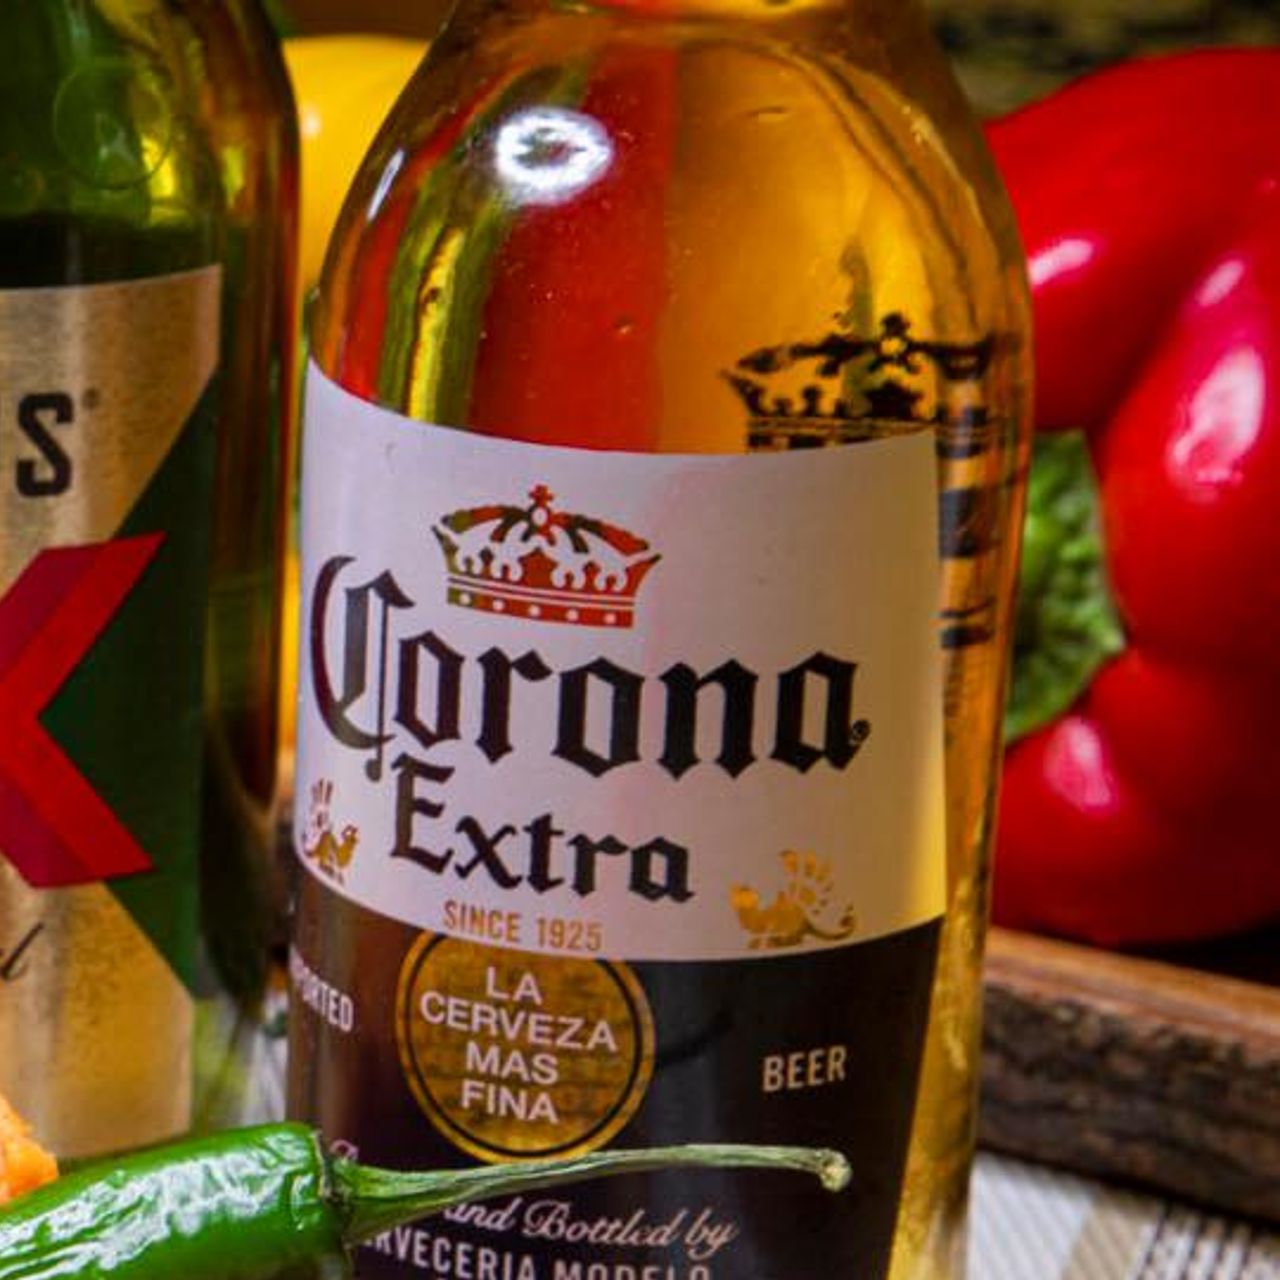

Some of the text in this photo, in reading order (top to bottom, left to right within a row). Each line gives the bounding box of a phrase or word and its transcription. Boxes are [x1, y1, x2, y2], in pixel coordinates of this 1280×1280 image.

[310, 555, 870, 783] Corona
[390, 752, 695, 904] Extra
[443, 900, 603, 952] SINCE 1925
[485, 966, 543, 1005] LA
[420, 990, 619, 1053] CERVEZA
[465, 1041, 560, 1085] MAS
[762, 1045, 848, 1093] BEER
[460, 1080, 560, 1125] FINA
[522, 1200, 689, 1248] Bottled
[684, 1207, 738, 1261] by
